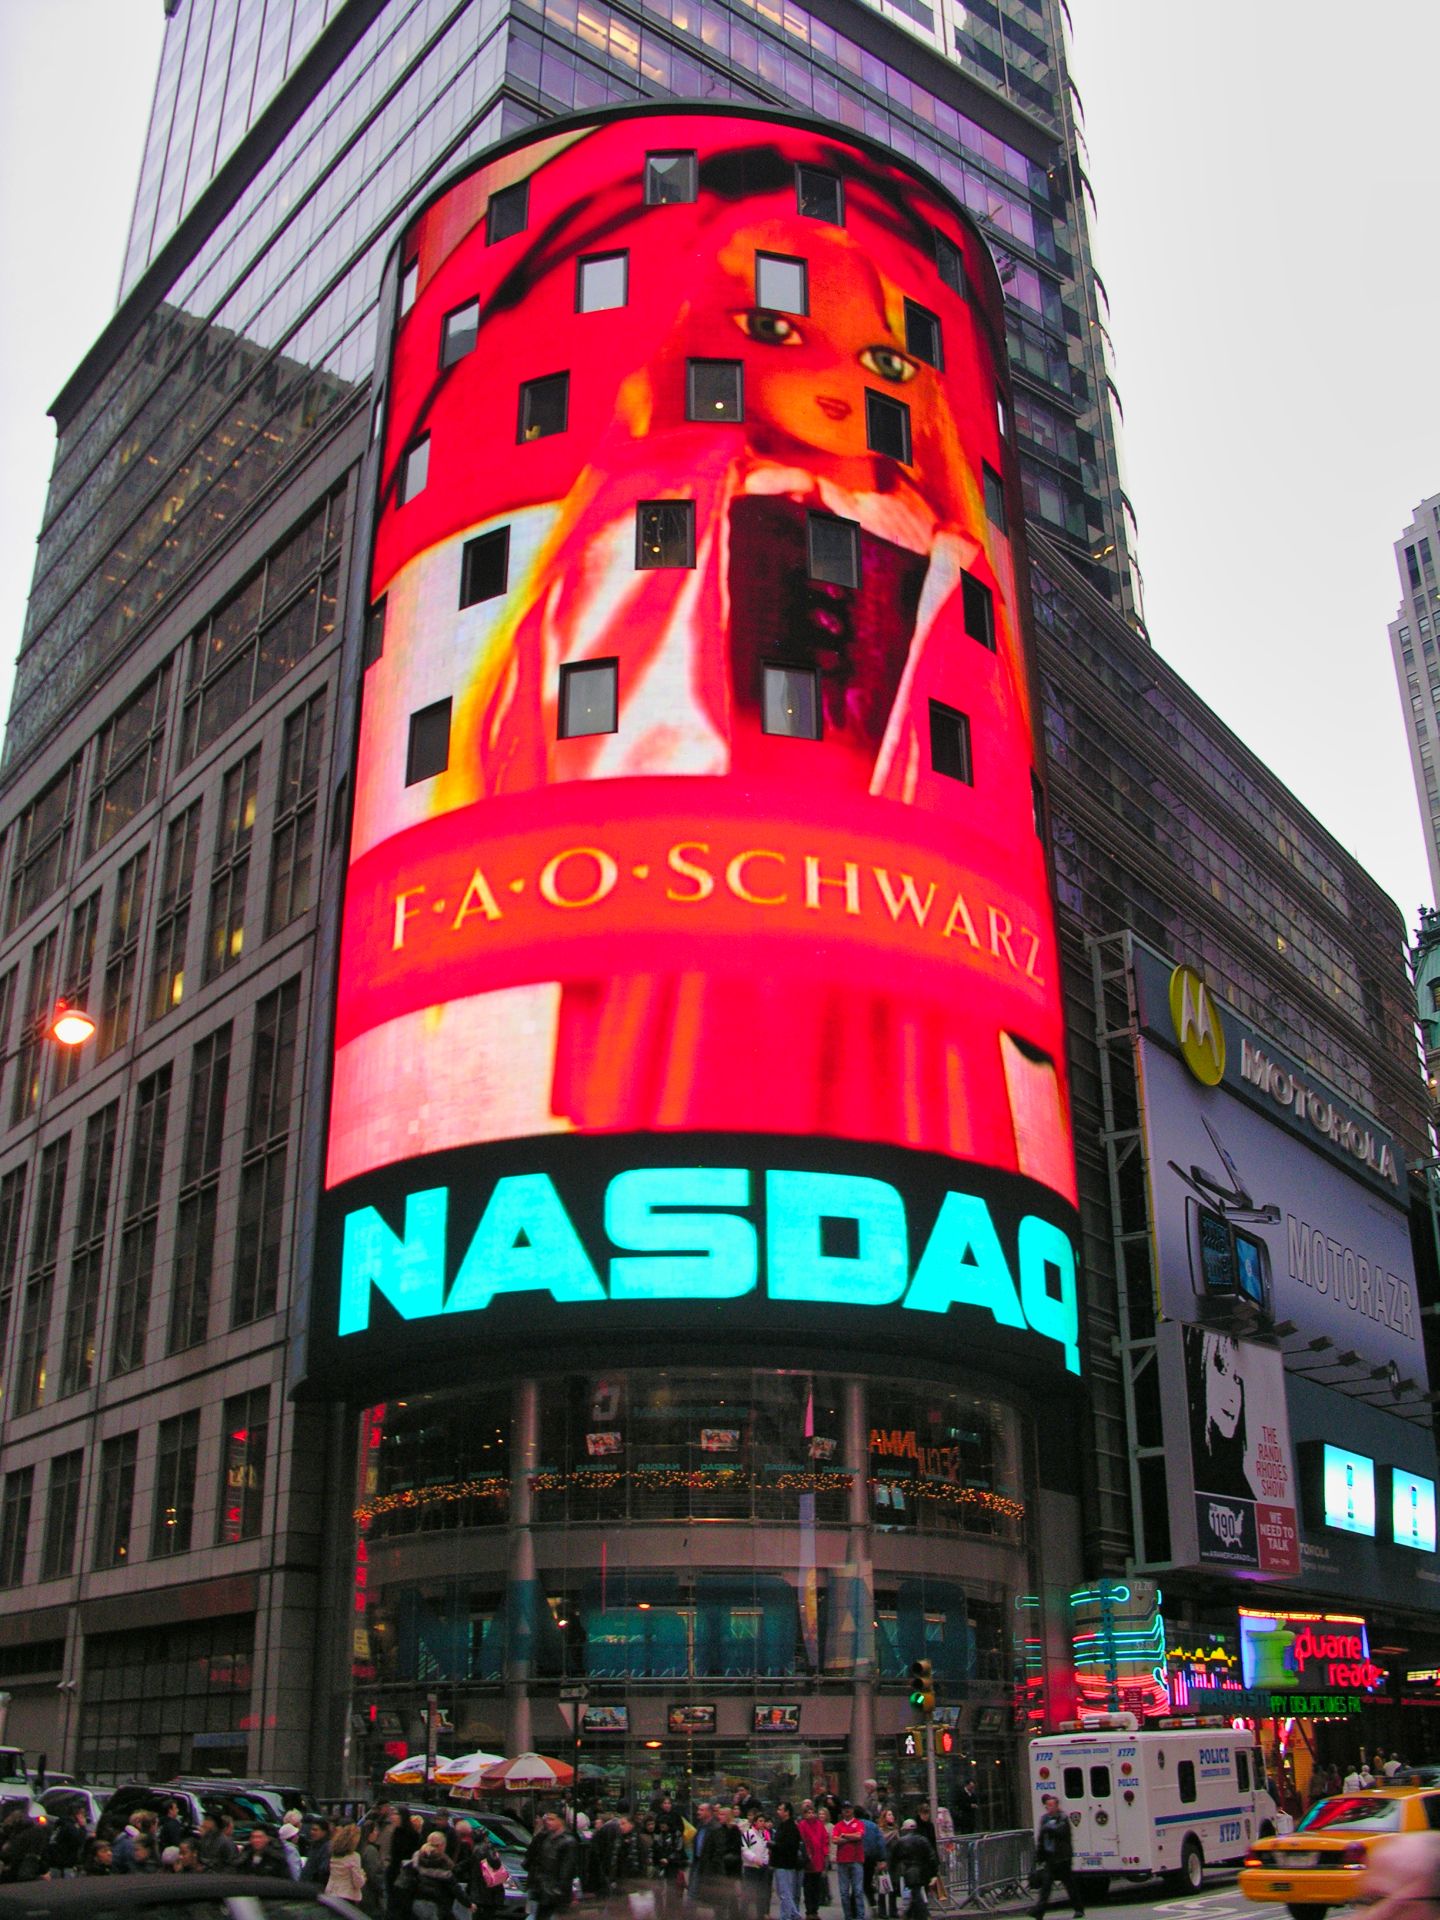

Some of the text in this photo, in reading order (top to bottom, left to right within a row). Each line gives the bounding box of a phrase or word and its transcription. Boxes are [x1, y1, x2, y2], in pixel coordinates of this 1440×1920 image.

[1240, 1038, 1399, 1185] MOTOROLA
[338, 1167, 1081, 1376] NASDAQ
[1287, 1213, 1416, 1341] MOTORAZR
[1262, 1426, 1278, 1445] THE
[1257, 1443, 1283, 1463] RANDI
[1256, 1460, 1288, 1482] RHODES
[1261, 1480, 1286, 1498] SHOW
[1211, 1511, 1236, 1539] 1190
[1269, 1511, 1283, 1525] WE
[1260, 1523, 1294, 1540] NEED TO
[1267, 1537, 1289, 1552] TALK
[1294, 1626, 1362, 1664] duane
[1036, 1752, 1053, 1761] NYPD
[1117, 1747, 1136, 1757] NYPD
[1199, 1748, 1230, 1764] POLICE
[1035, 1782, 1056, 1790] POLICE
[1118, 1778, 1139, 1787] POLICE
[1219, 1821, 1241, 1843] NYPD
